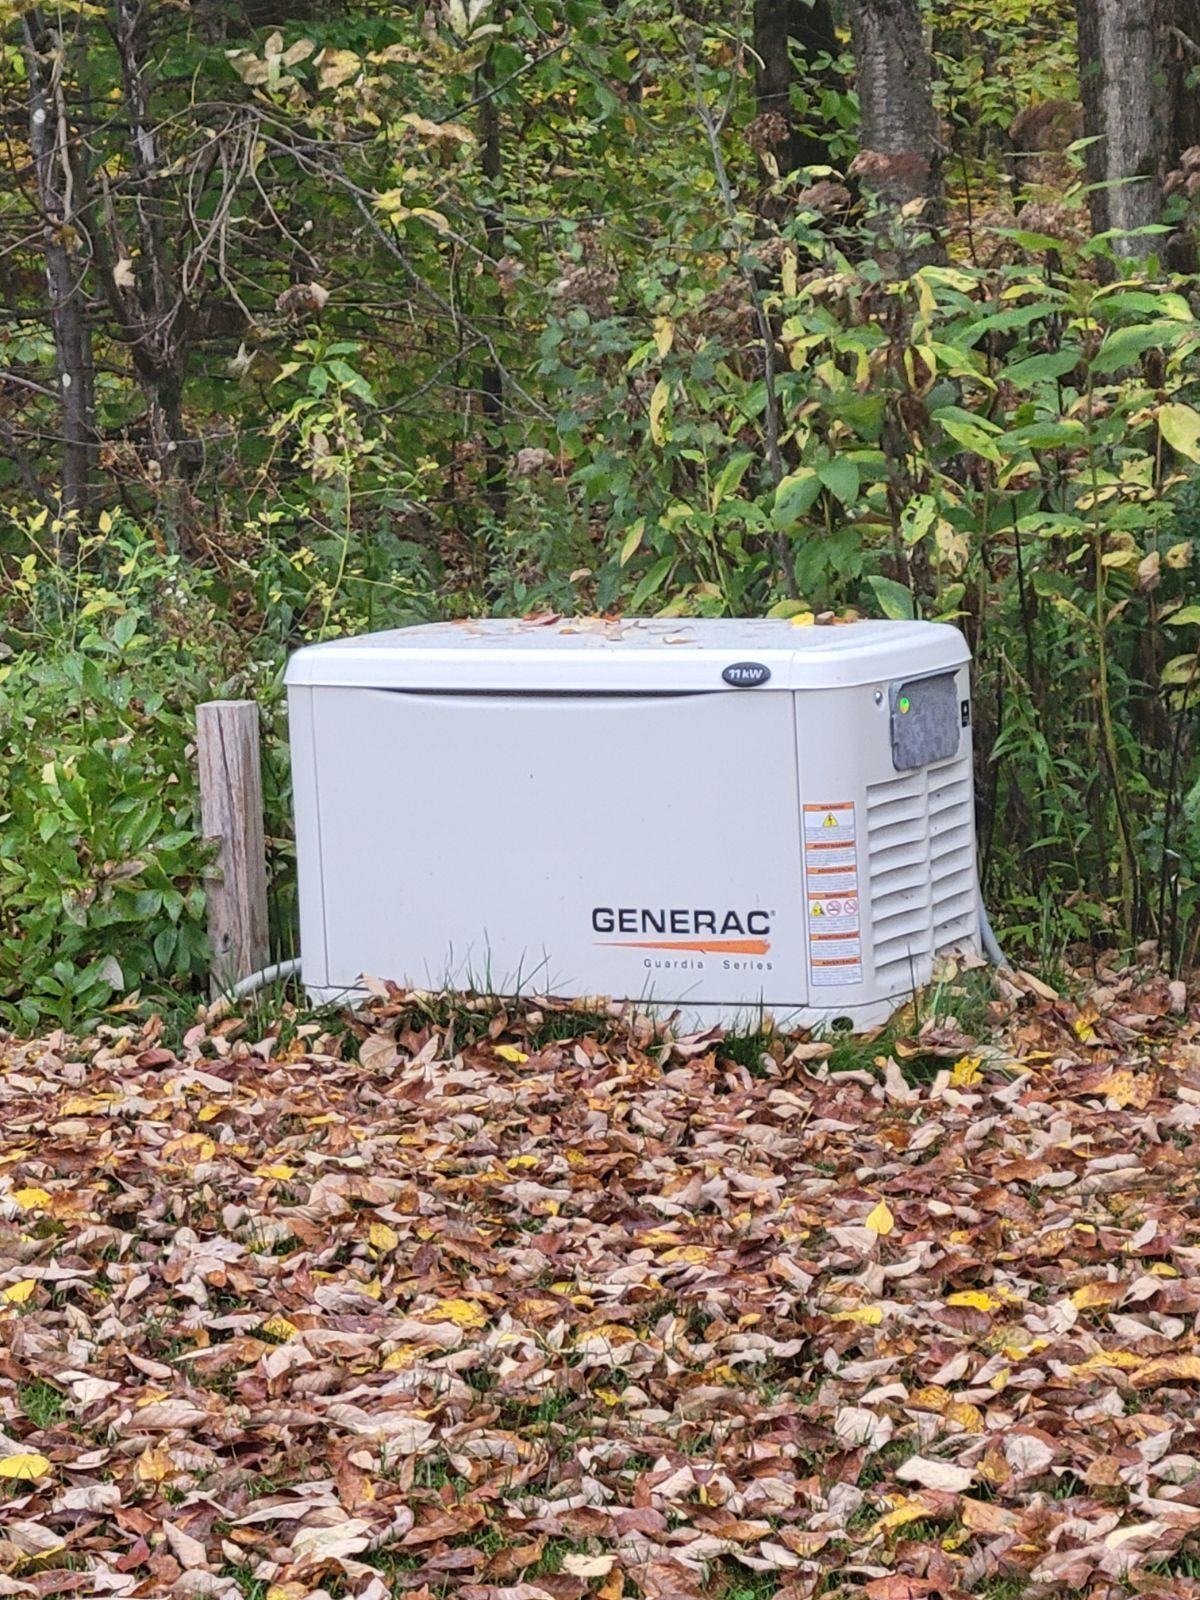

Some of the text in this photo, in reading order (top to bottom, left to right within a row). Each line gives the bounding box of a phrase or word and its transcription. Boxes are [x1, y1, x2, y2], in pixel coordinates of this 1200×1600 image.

[592, 907, 771, 935] GENERAC
[644, 958, 773, 970] Guardia Series
